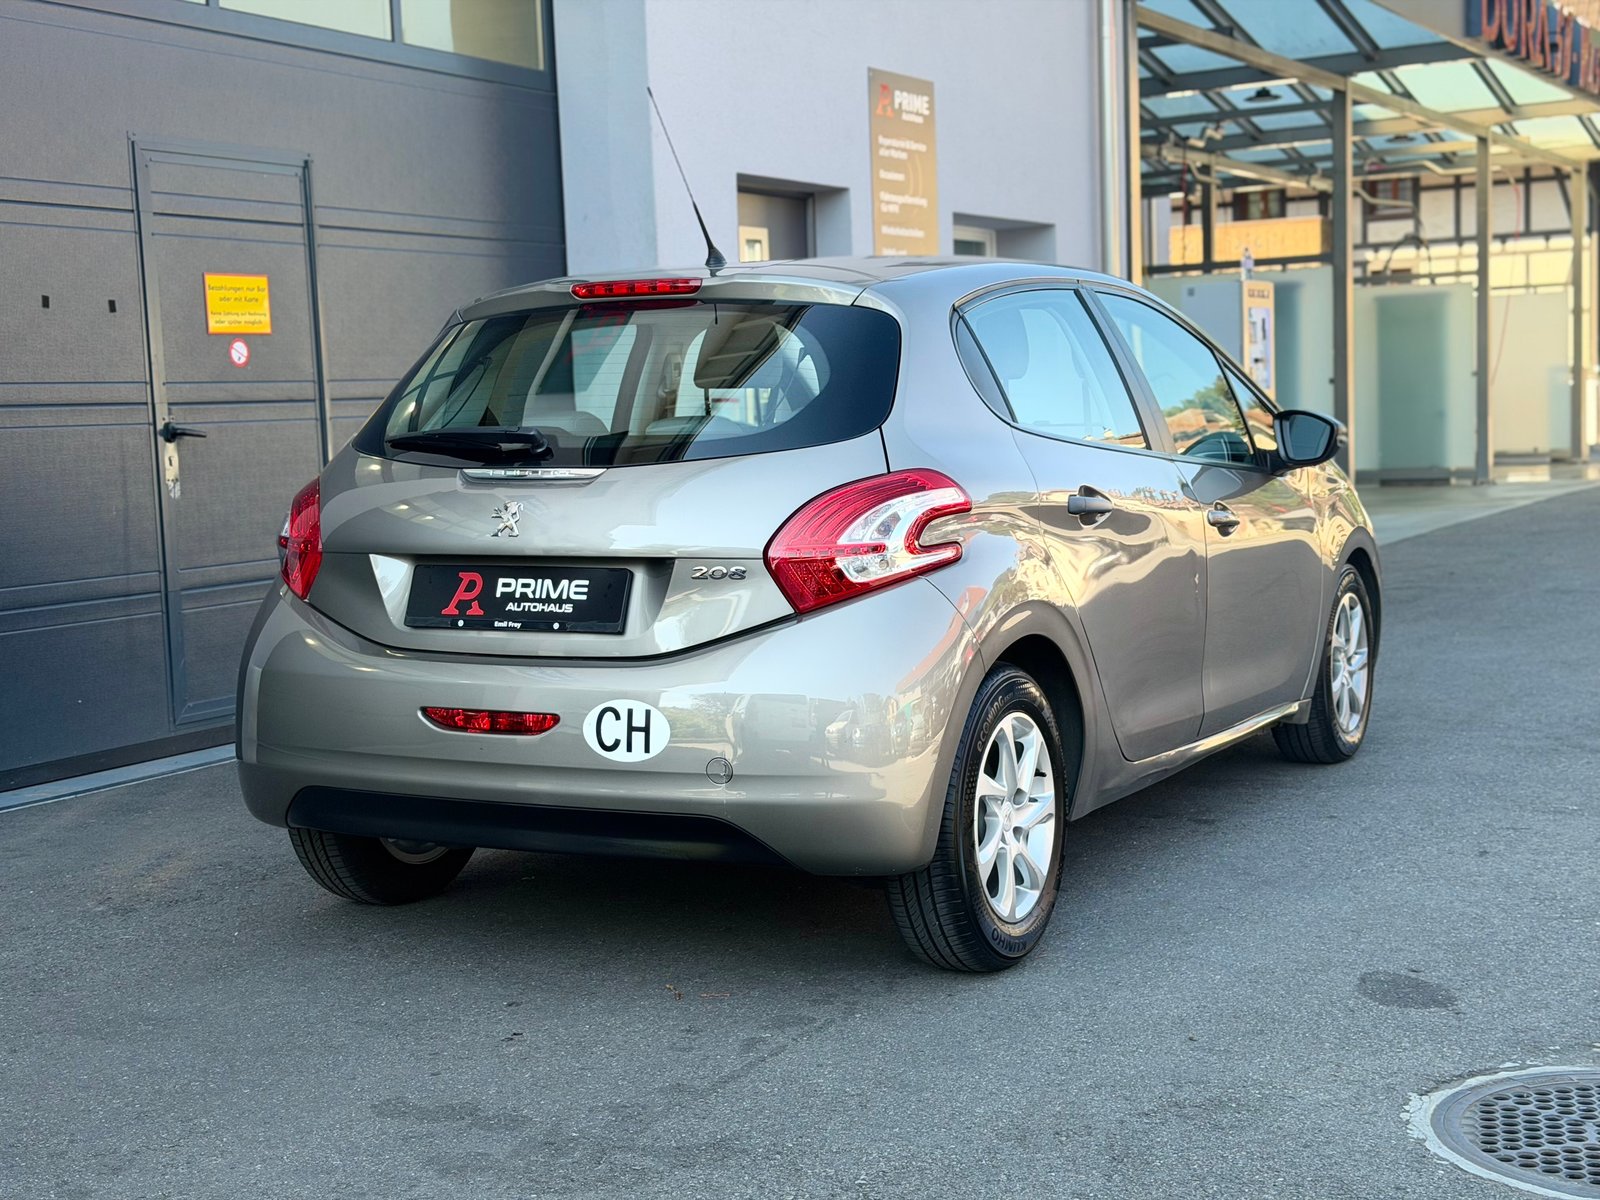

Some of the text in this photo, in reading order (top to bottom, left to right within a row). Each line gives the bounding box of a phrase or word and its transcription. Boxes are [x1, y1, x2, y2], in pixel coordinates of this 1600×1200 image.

[893, 89, 931, 116] PRIME
[691, 565, 747, 580] 208
[496, 577, 590, 600] PRIME
[505, 602, 574, 613] AUTOHAUS
[508, 621, 522, 629] Frey
[595, 706, 651, 754] CH
[991, 927, 1028, 953] KUMHO
